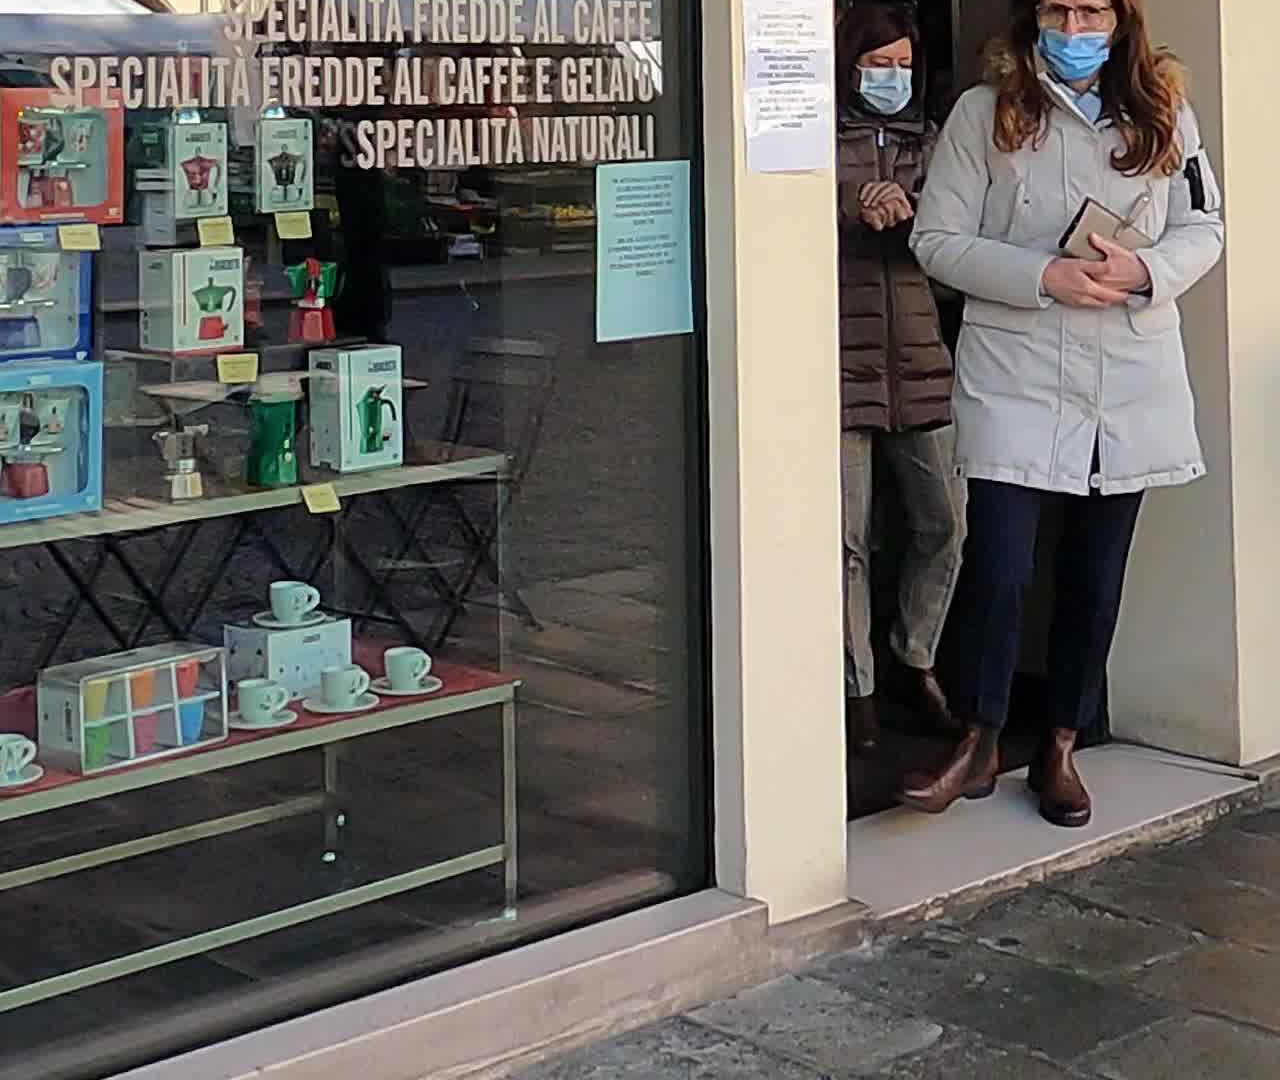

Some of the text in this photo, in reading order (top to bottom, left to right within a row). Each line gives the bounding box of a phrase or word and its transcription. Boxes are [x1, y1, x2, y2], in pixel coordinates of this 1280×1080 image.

[50, 46, 655, 110] SPECIALITÀ FREDDE AL CAFFÈ E GELATO
[356, 107, 654, 170] SPECIALITÀ NATURALI
